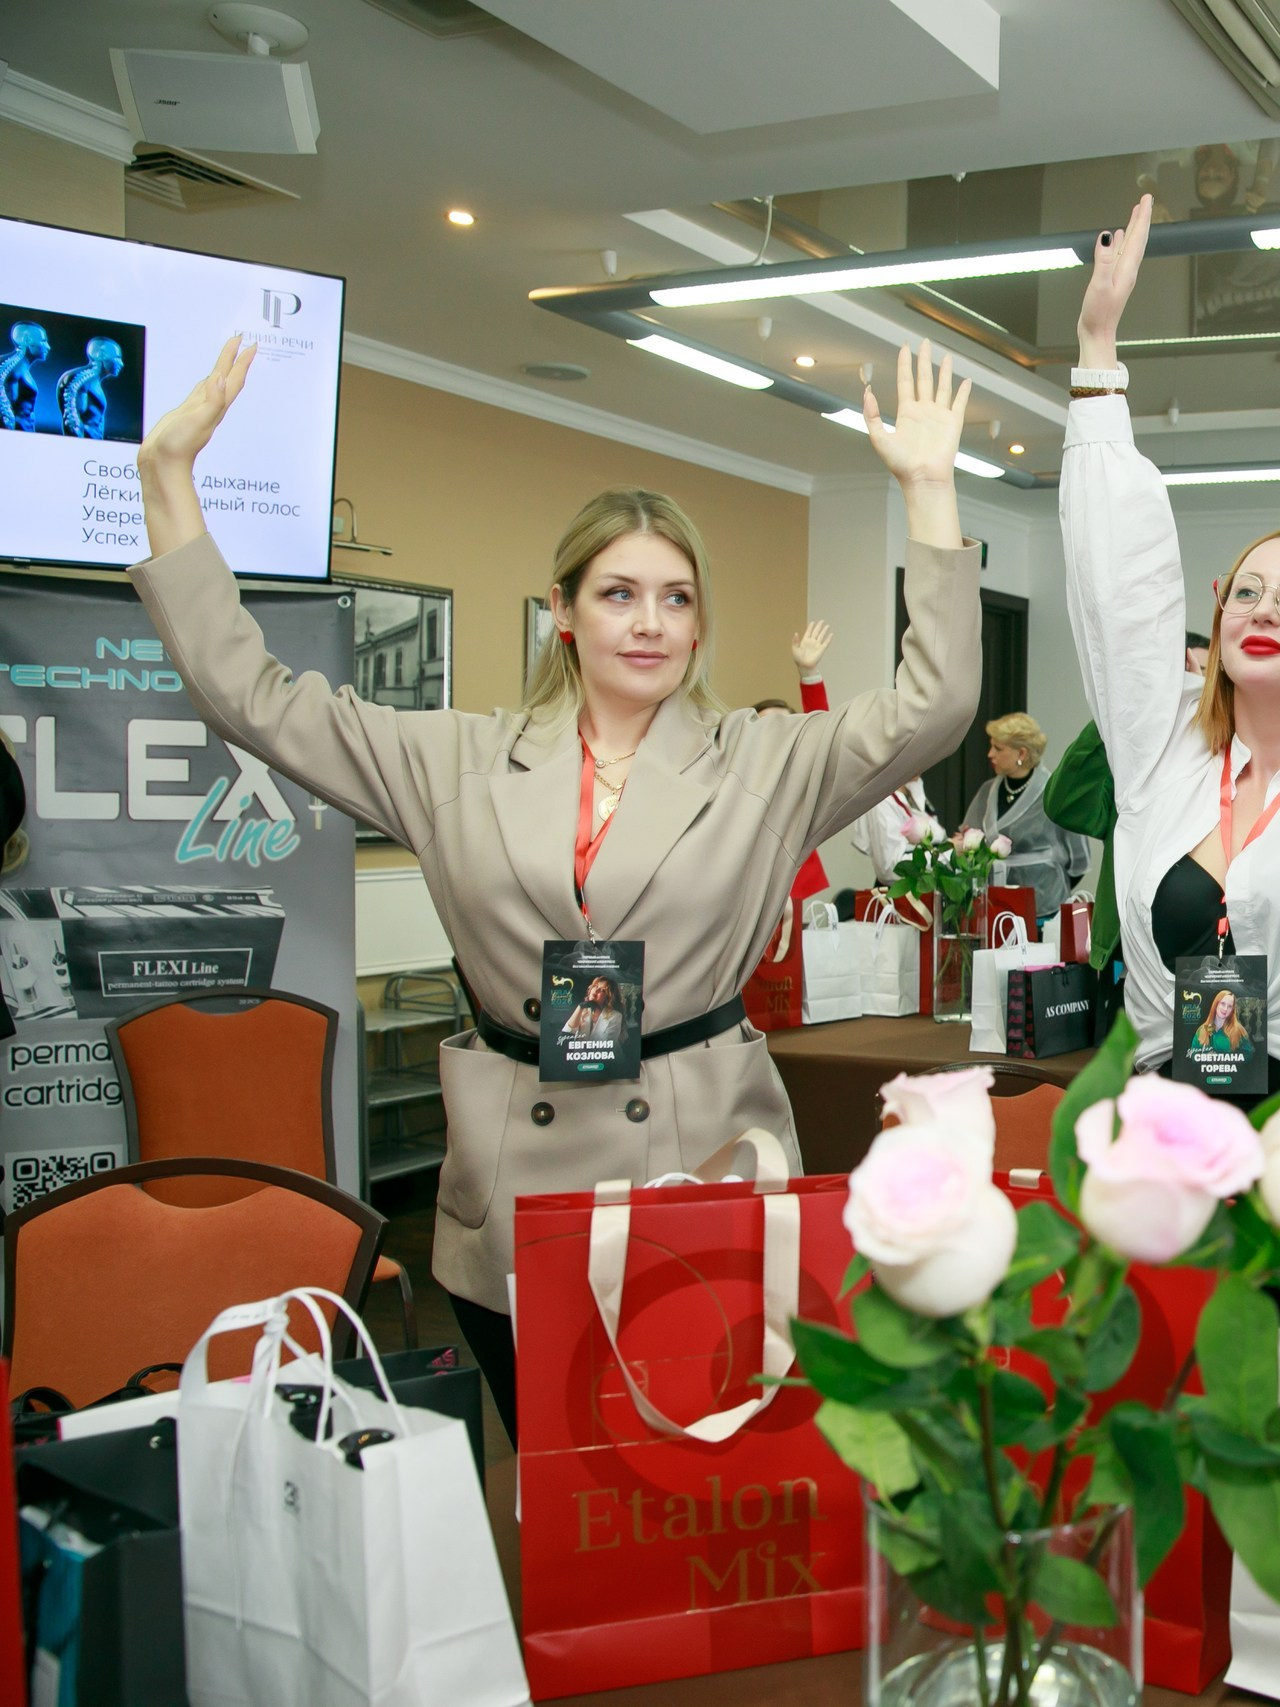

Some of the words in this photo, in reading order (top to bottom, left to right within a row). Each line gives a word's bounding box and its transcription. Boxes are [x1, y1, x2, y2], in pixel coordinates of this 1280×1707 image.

[281, 336, 314, 350] РЕЧИ
[201, 475, 280, 493] дыхание
[82, 482, 144, 503] Лёгки
[251, 502, 301, 517] голос
[82, 504, 146, 527] Увере
[82, 527, 138, 546] Успех
[96, 637, 171, 662] NE
[175, 777, 300, 867] Line
[132, 960, 189, 977] FLEXI
[191, 962, 219, 975] Line
[180, 977, 215, 988] cartridge
[1045, 1006, 1055, 1019] AS
[1055, 1000, 1089, 1016] COMPANY
[568, 1040, 614, 1050] ЕВГЕНИЯ
[566, 1051, 615, 1061] КОЗЛОВА
[1194, 1053, 1245, 1062] СВЕТЛАНА
[1201, 1064, 1237, 1073] ГОРЕВА
[572, 1475, 827, 1553] Etalon
[688, 1540, 828, 1612] Mix
